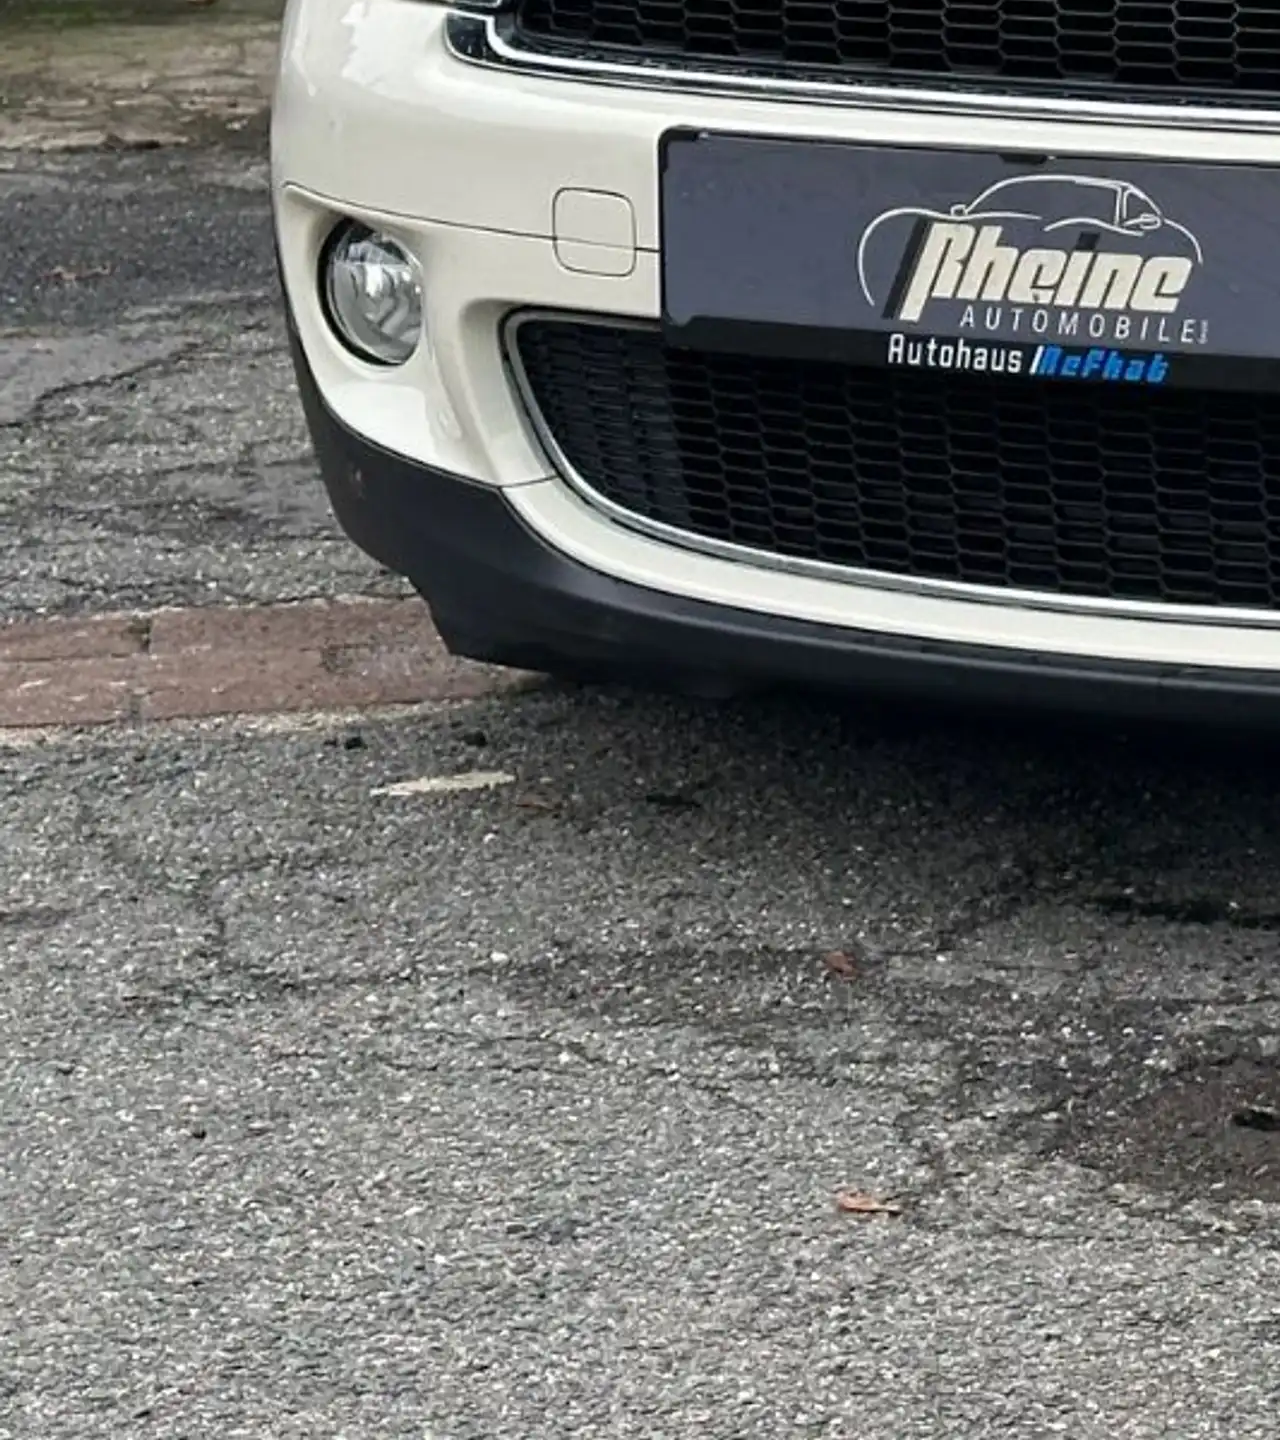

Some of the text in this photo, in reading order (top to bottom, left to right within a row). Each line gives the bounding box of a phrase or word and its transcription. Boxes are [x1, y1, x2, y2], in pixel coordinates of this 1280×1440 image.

[899, 220, 1193, 323] Rheine
[959, 305, 1198, 345] AUTOMOBILE
[887, 333, 1023, 373] Autohaus
